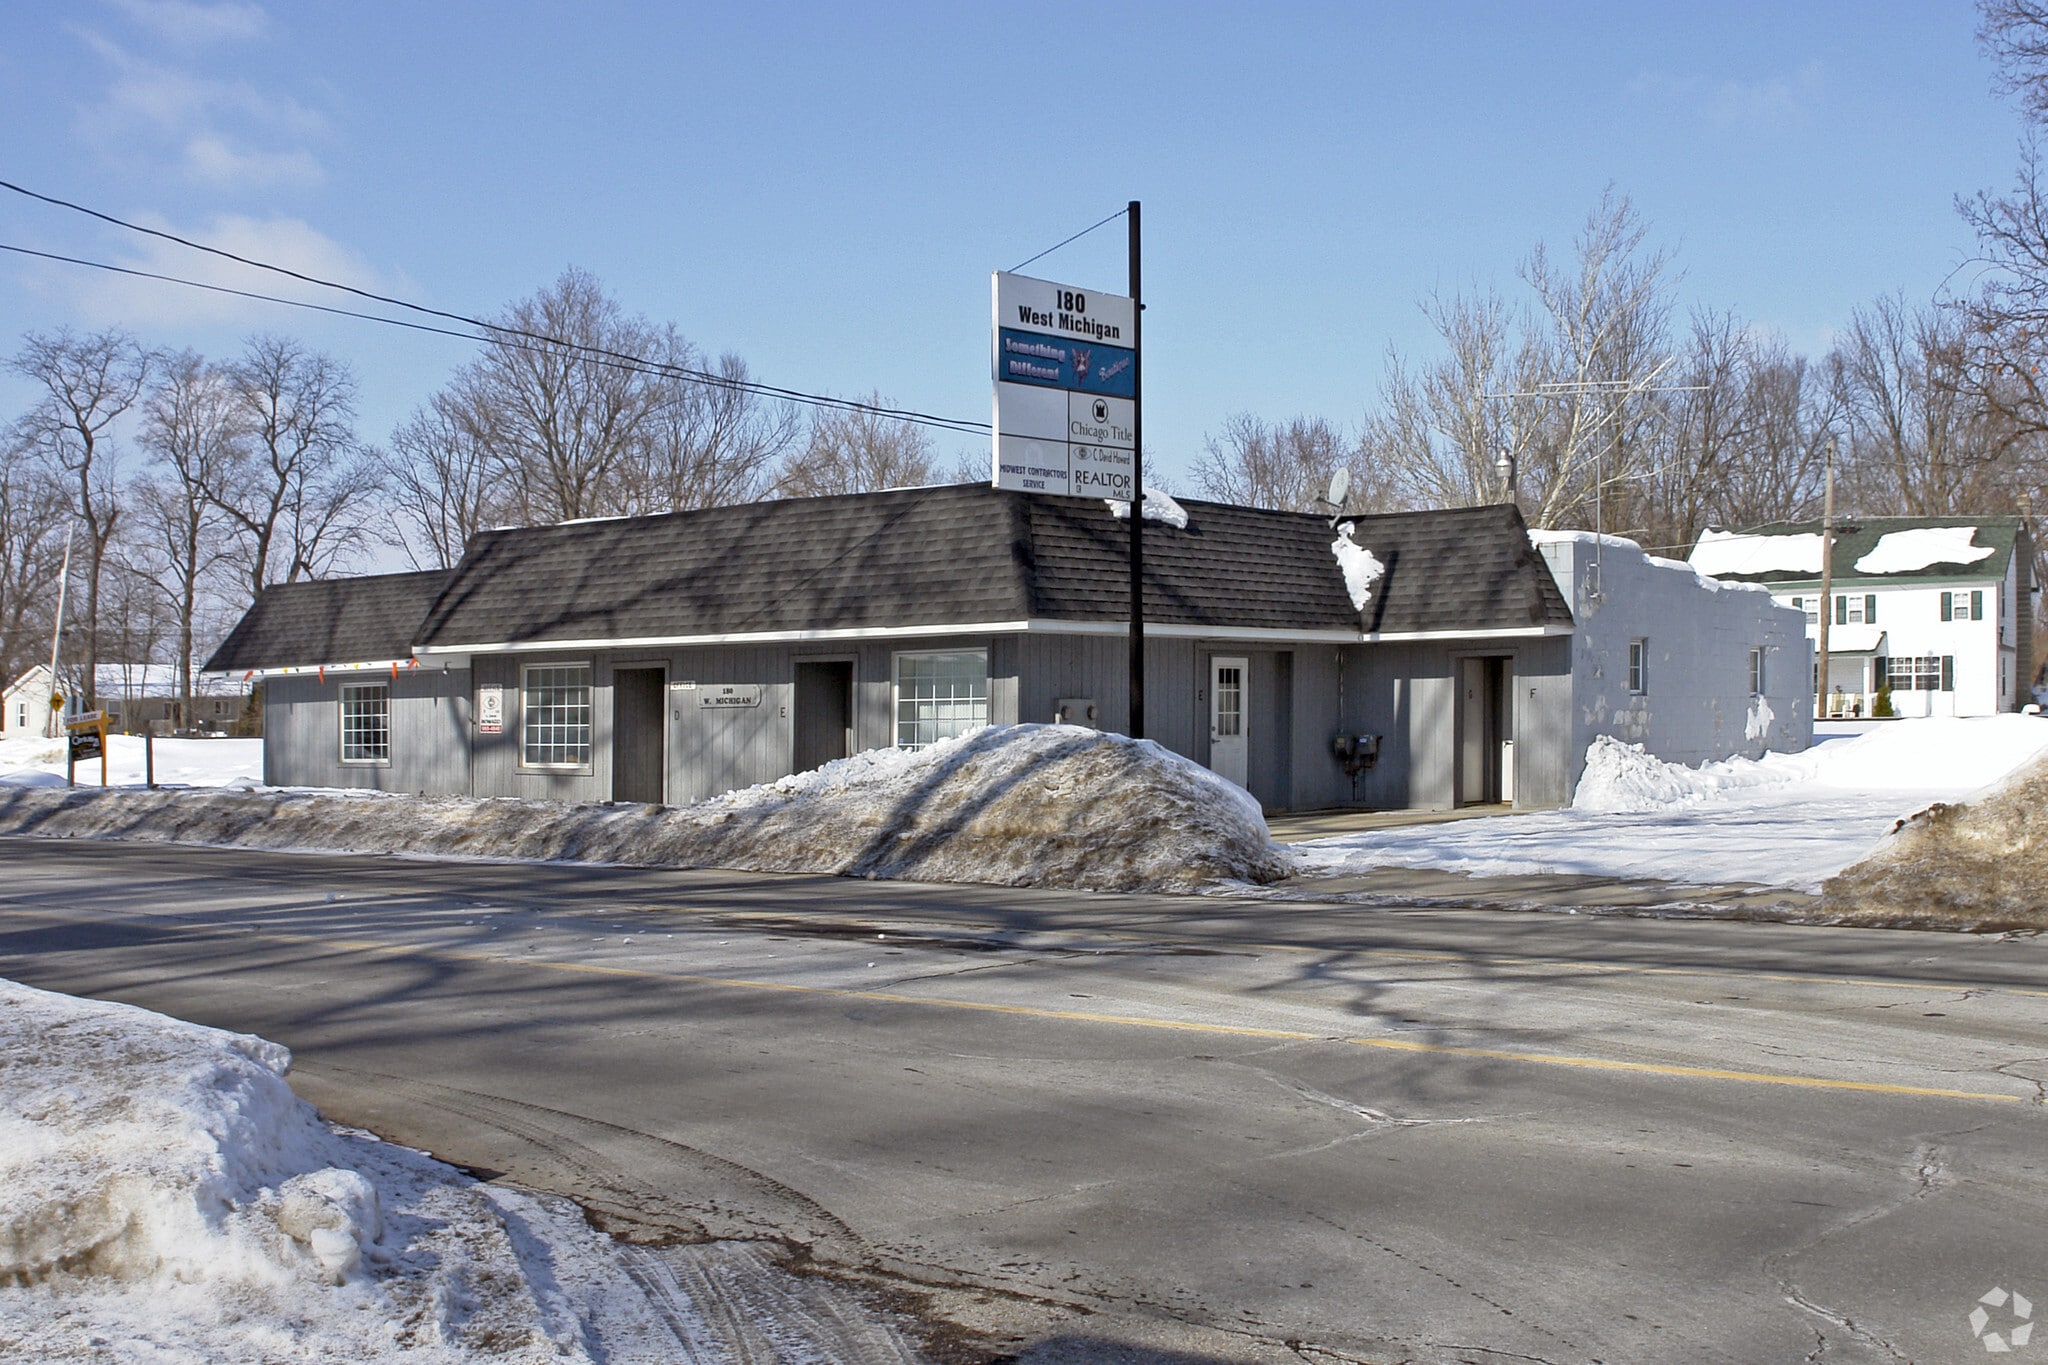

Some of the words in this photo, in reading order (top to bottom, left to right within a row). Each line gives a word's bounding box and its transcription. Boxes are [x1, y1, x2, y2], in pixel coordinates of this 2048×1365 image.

[1057, 289, 1085, 313] 180
[1018, 305, 1053, 328] West
[1058, 312, 1120, 340] Michigan
[1005, 337, 1065, 363] Something
[1009, 360, 1059, 381] Different
[1070, 420, 1109, 443] Chicago
[1111, 425, 1133, 442] Title
[1098, 448, 1113, 463] David
[1000, 464, 1026, 475] MIDWEST
[1027, 466, 1067, 479] CONTRACTORS
[1075, 469, 1131, 489] REALTOR
[1022, 479, 1046, 489] SERVICE
[1112, 489, 1131, 499] MLS
[703, 697, 712, 705] W.
[716, 697, 752, 705] MICHIGAN
[1198, 690, 1203, 701] E
[1530, 688, 1536, 699] F
[780, 707, 786, 718] E
